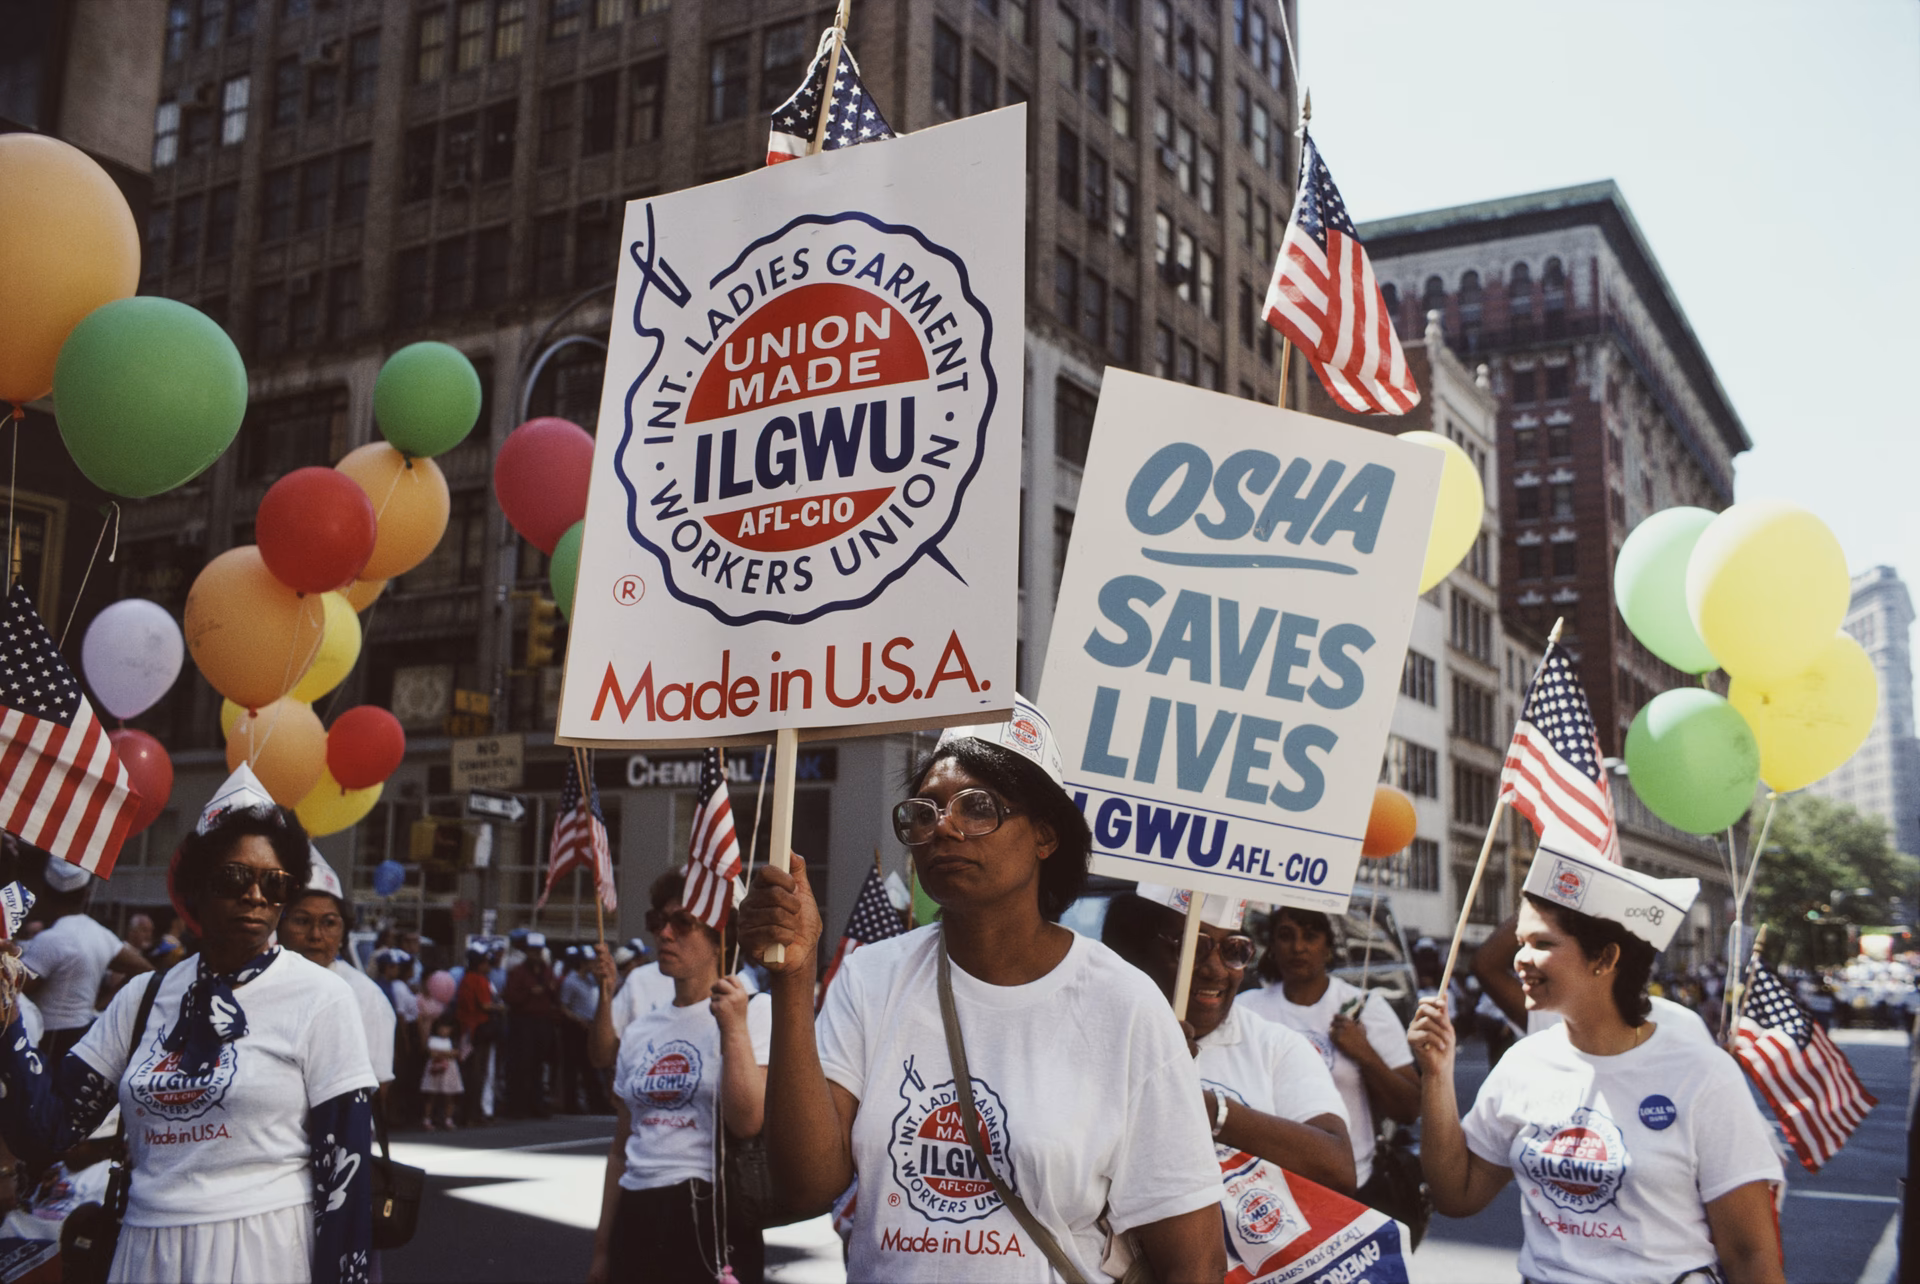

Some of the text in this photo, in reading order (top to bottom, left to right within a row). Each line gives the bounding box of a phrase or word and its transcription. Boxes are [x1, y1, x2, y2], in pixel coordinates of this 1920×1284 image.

[644, 243, 969, 444] INT. LADIES GARMENT
[724, 307, 891, 373] UNION
[727, 348, 881, 410] MADE
[694, 396, 915, 504] ILGWU
[650, 434, 960, 595] WORKERS UNION
[737, 496, 855, 539] AFL-CIO
[1125, 442, 1396, 554] OSHA
[1083, 574, 1377, 710] SAVES
[590, 629, 991, 724] Made in U.S.A.
[477, 740, 500, 755] NO
[1080, 685, 1339, 812] LIVES
[137, 1077, 225, 1115] WORKERS UNION
[644, 1074, 687, 1091] ILGWU
[919, 1090, 957, 1114] LADI
[1640, 1106, 1665, 1117] LOCAL
[144, 1126, 177, 1145] Made
[179, 1127, 191, 1144] in
[936, 1126, 967, 1143] MA
[1552, 1144, 1598, 1159] MADE
[1554, 1135, 1601, 1149] UNION
[920, 1144, 987, 1180] ILGW
[1540, 1157, 1604, 1183] ILGWU
[902, 1160, 967, 1213] WORKERS
[1530, 1165, 1614, 1207] WORKERS UNION
[880, 1227, 1026, 1258] Made in U.S.A.
[1277, 1226, 1365, 1283] The job you save
